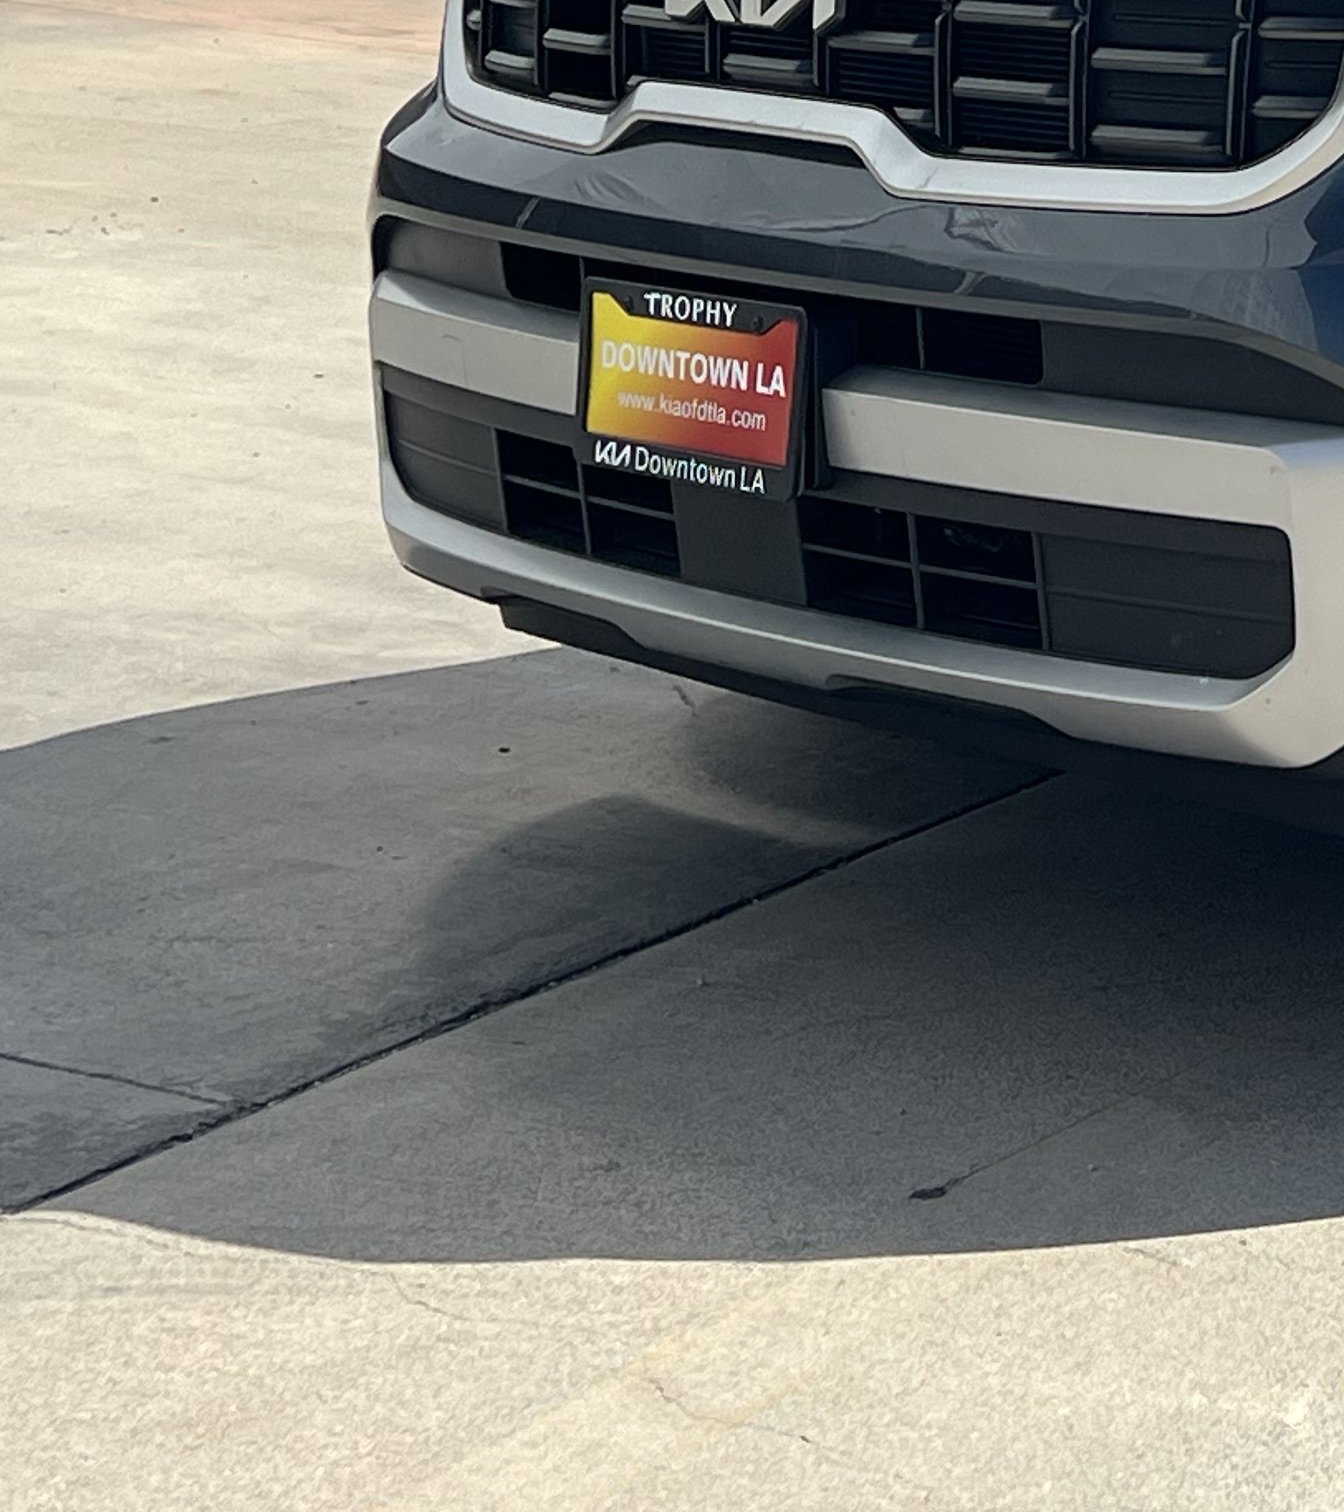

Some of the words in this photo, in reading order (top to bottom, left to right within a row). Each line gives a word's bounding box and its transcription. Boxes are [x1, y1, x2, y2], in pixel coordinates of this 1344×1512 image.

[643, 292, 737, 327] TROPHY
[601, 340, 748, 392] DOWNTOWN
[755, 362, 787, 397] LA
[617, 392, 766, 431] www.kiaofdtla.com
[594, 439, 632, 467] KIA
[634, 445, 736, 488] Downtown
[738, 465, 766, 494] LA
